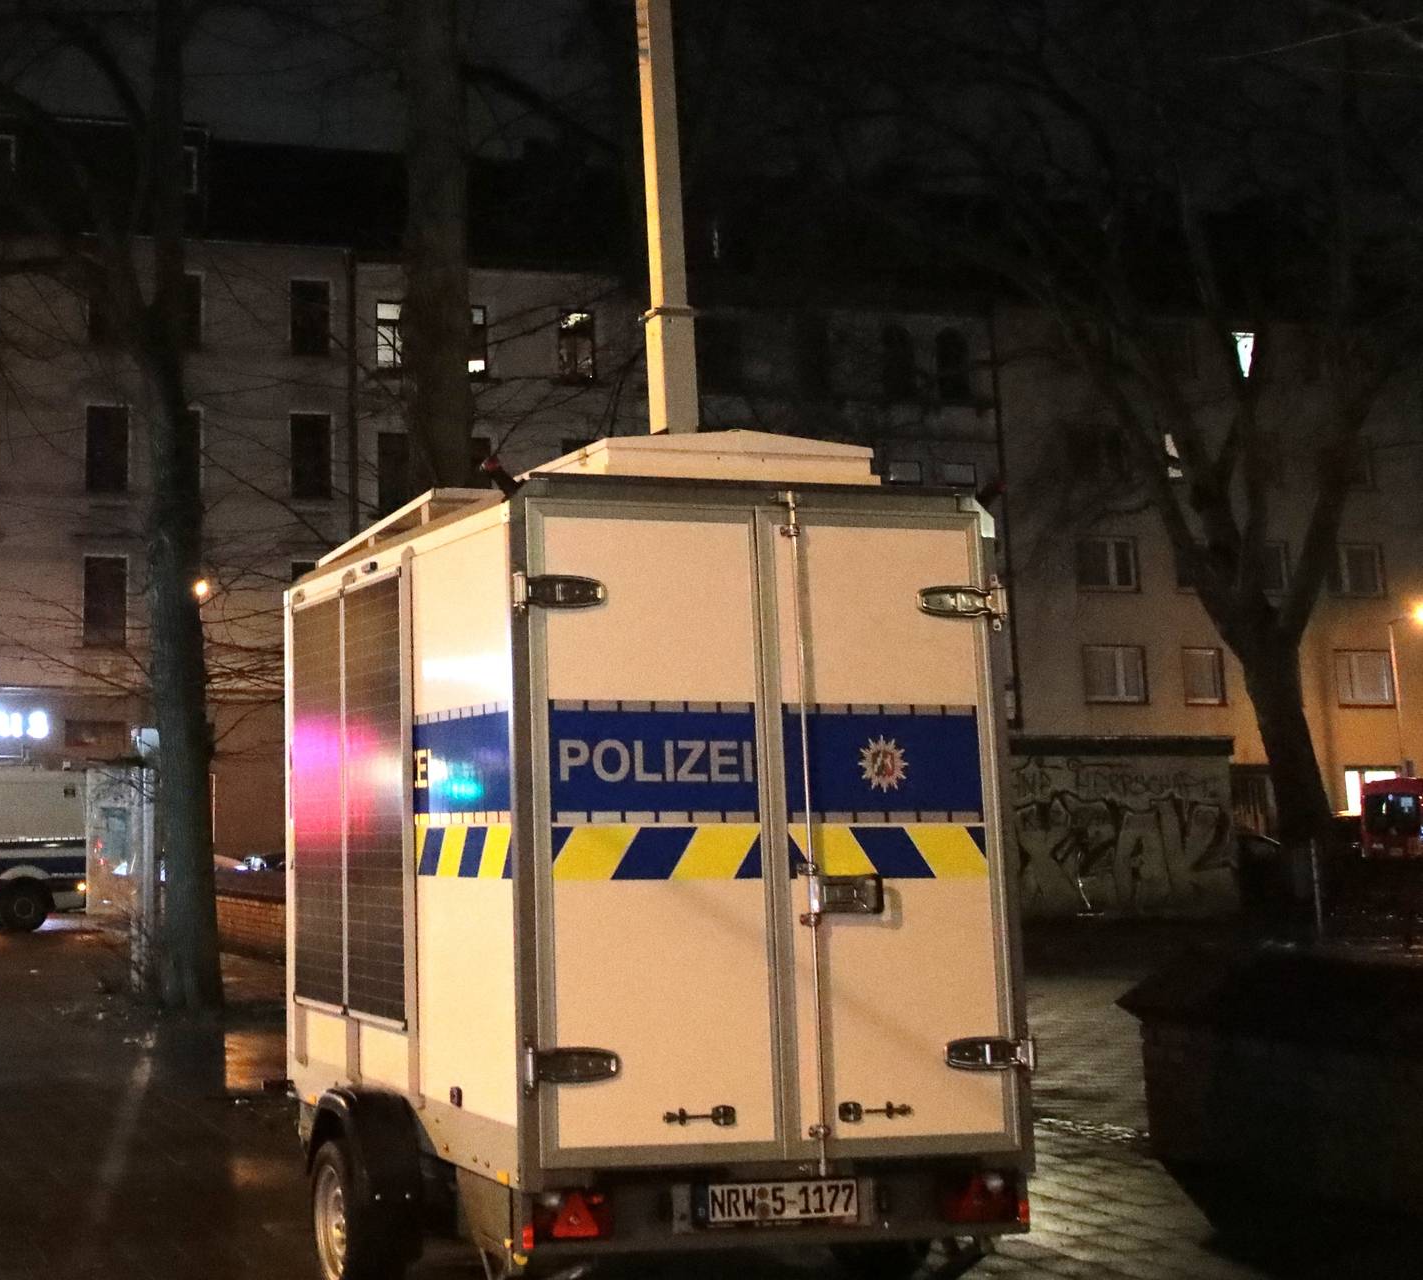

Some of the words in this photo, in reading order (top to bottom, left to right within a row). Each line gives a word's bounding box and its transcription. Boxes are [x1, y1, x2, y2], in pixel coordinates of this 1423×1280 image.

[559, 738, 754, 783] POLIZEI
[710, 1188, 757, 1218] NRW
[772, 1184, 854, 1215] 5-1177
